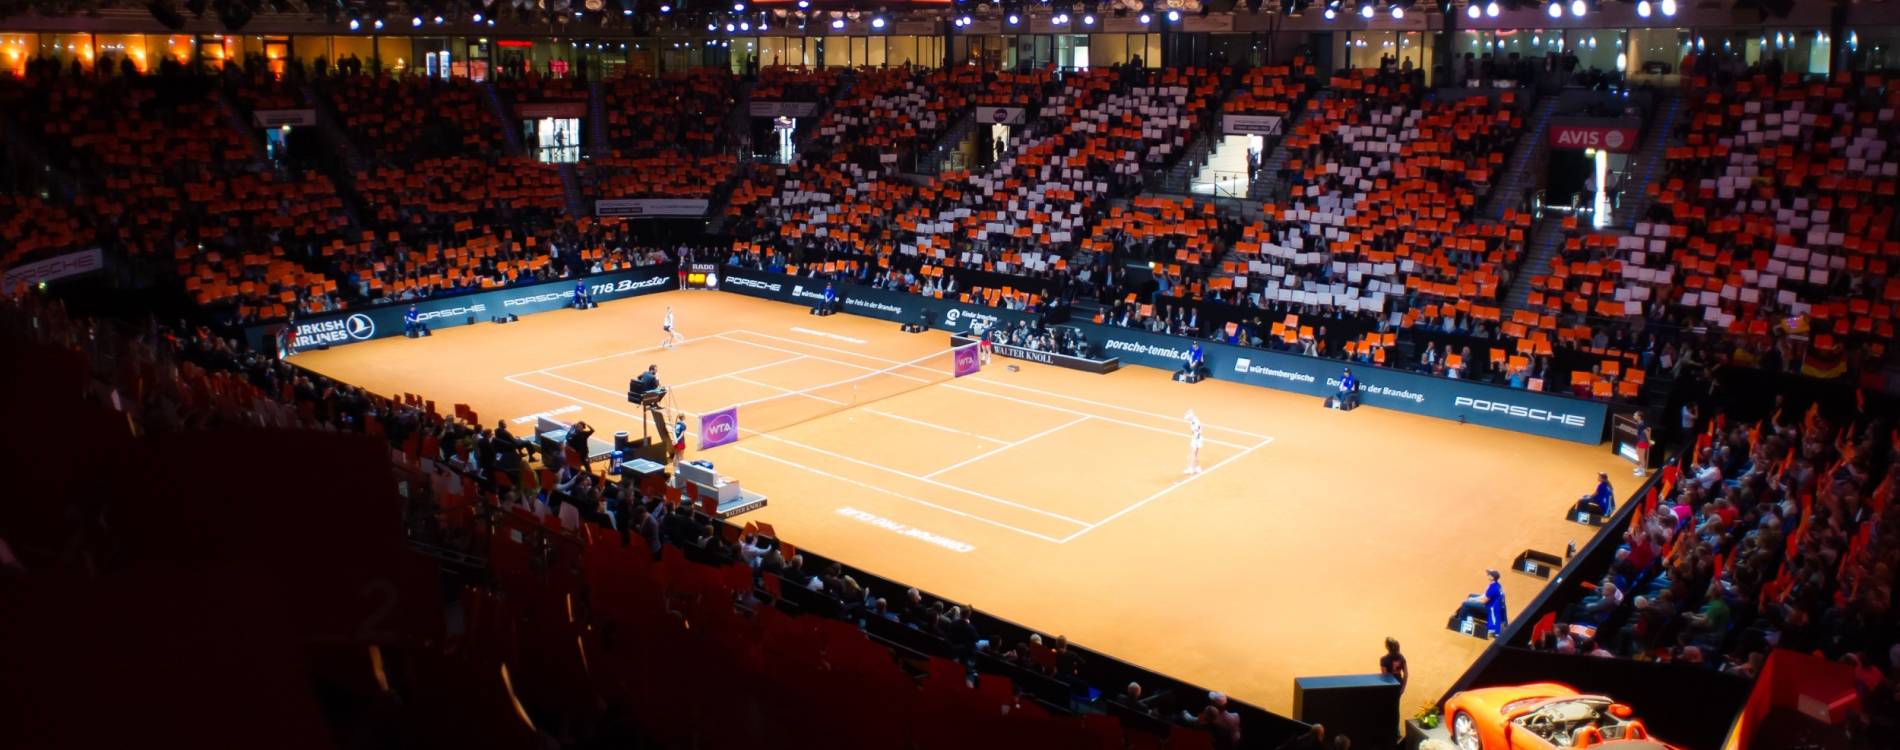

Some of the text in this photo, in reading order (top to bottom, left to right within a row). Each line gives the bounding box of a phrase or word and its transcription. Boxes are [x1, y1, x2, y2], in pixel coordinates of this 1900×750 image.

[1558, 130, 1599, 144] AVIS
[591, 276, 670, 295] 718 Boxster
[725, 275, 781, 291] PORSCHE
[503, 290, 575, 306] PORSCHE
[417, 304, 486, 321] ORSCHE
[994, 346, 1053, 364] WALTER KNOLL
[1250, 365, 1315, 383] württembergische
[1359, 382, 1367, 391] in
[1368, 384, 1381, 394] der
[1382, 387, 1424, 402] Brandung.
[1455, 396, 1586, 427] PORSCHE
[709, 423, 731, 435] WTA
